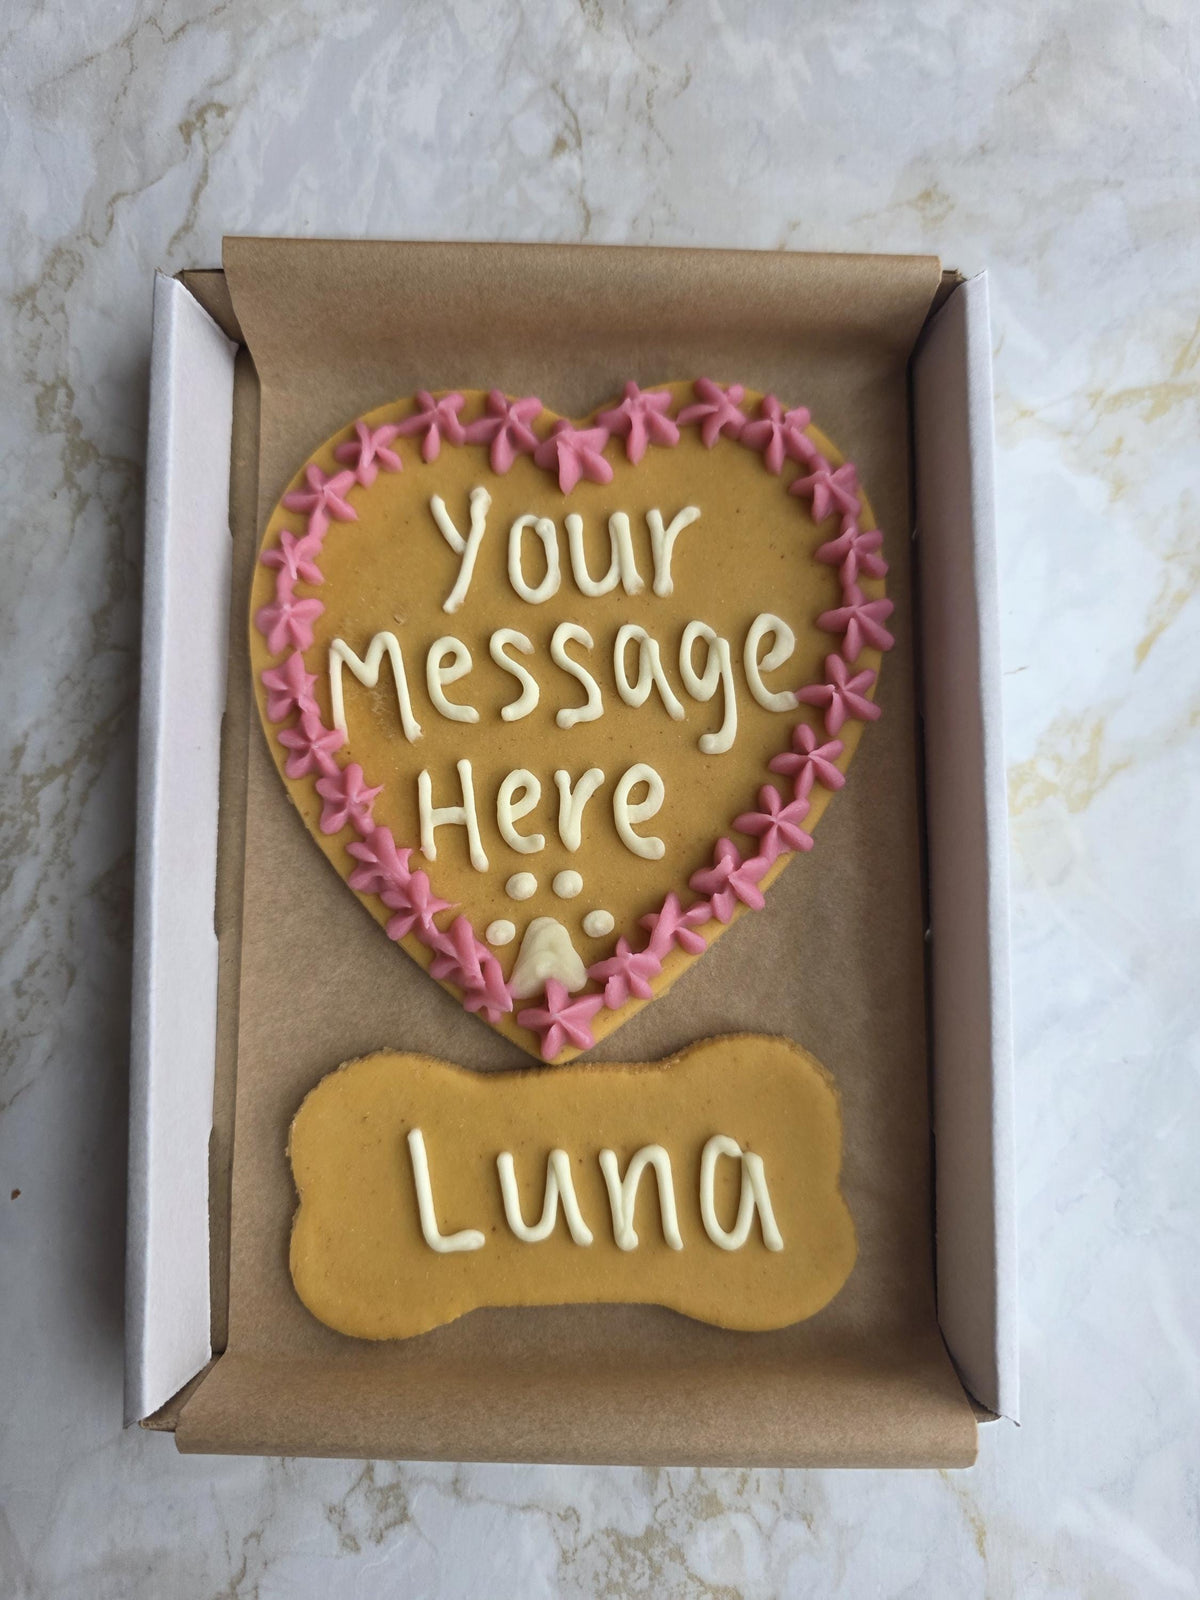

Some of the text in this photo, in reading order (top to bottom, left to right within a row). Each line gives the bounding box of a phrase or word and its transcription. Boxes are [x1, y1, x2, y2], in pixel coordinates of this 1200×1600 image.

[429, 486, 701, 613] Your
[328, 613, 799, 755] Message
[417, 758, 666, 872] Here
[407, 1128, 784, 1253] Luna
